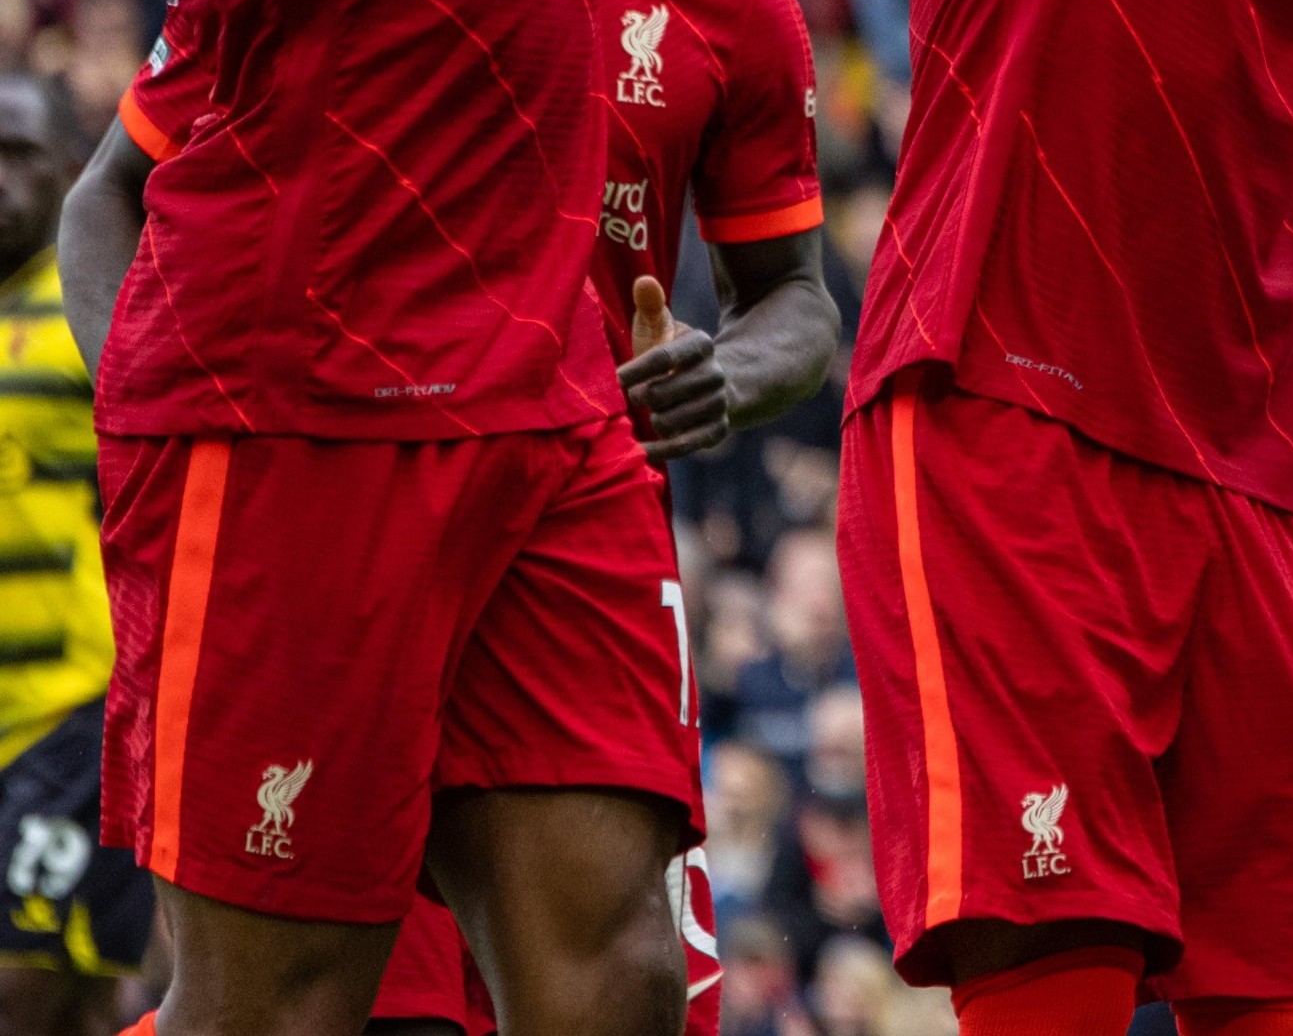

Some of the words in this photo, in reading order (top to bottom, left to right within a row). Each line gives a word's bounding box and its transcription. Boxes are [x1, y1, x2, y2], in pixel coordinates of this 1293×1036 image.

[616, 79, 666, 108] L.F.C.
[245, 831, 295, 860] L.F.C.
[1021, 853, 1071, 879] L.F.C.
